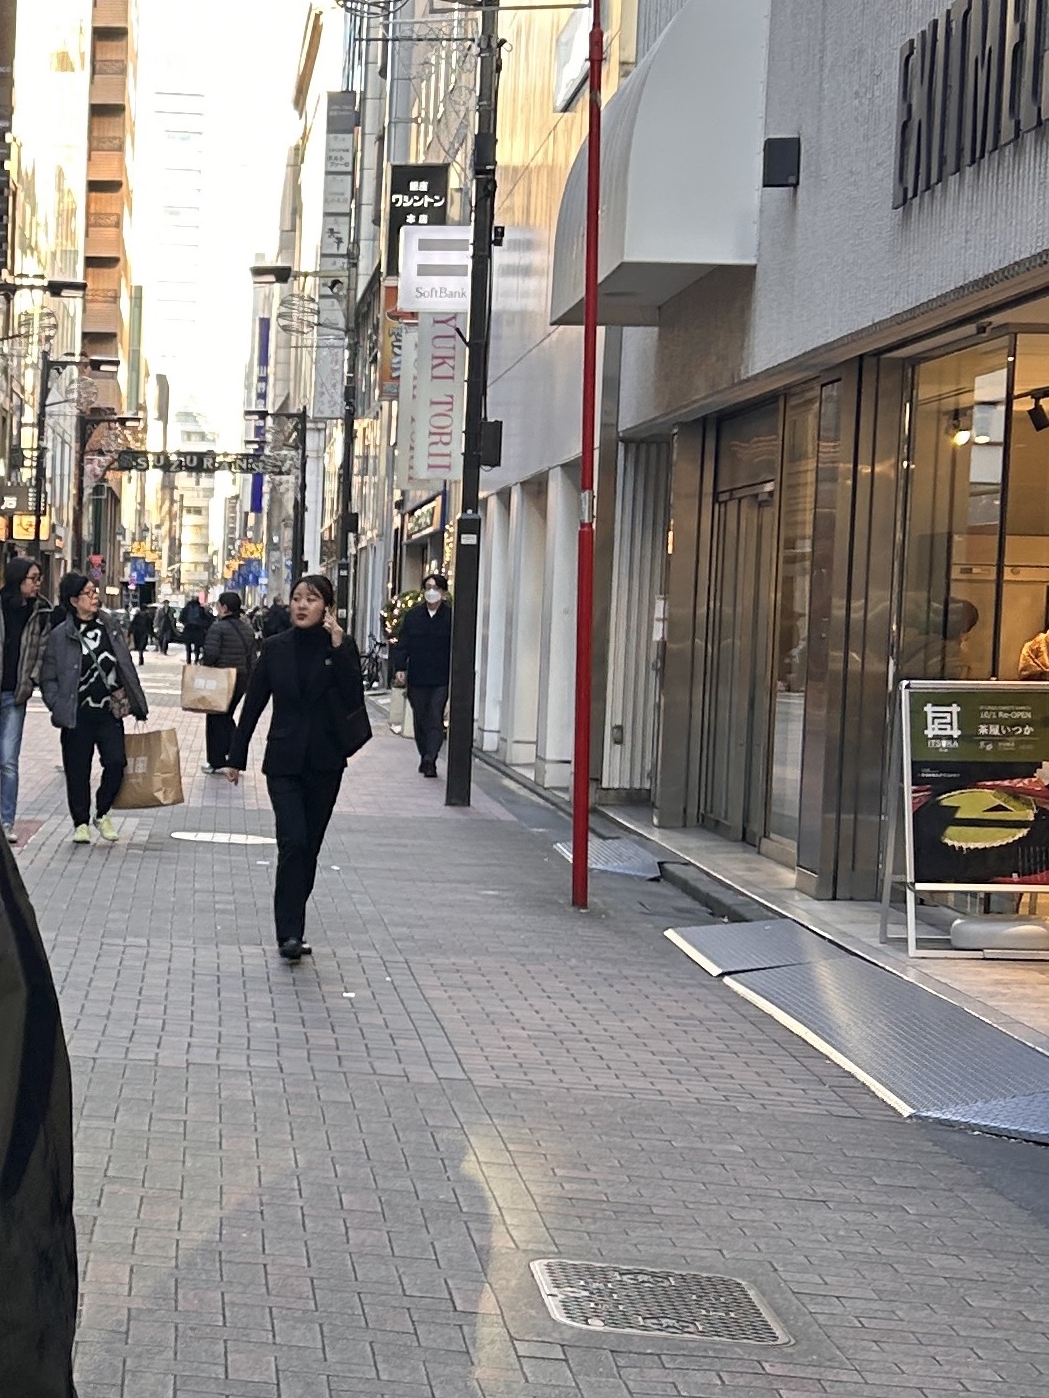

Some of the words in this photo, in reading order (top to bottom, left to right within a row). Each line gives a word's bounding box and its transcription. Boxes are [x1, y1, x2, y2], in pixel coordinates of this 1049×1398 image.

[391, 194, 445, 208] ワシントン
[415, 286, 467, 299] SoftBank
[430, 313, 457, 382] YUKI
[427, 394, 454, 472] TORII
[137, 454, 250, 473] SUZURAN
